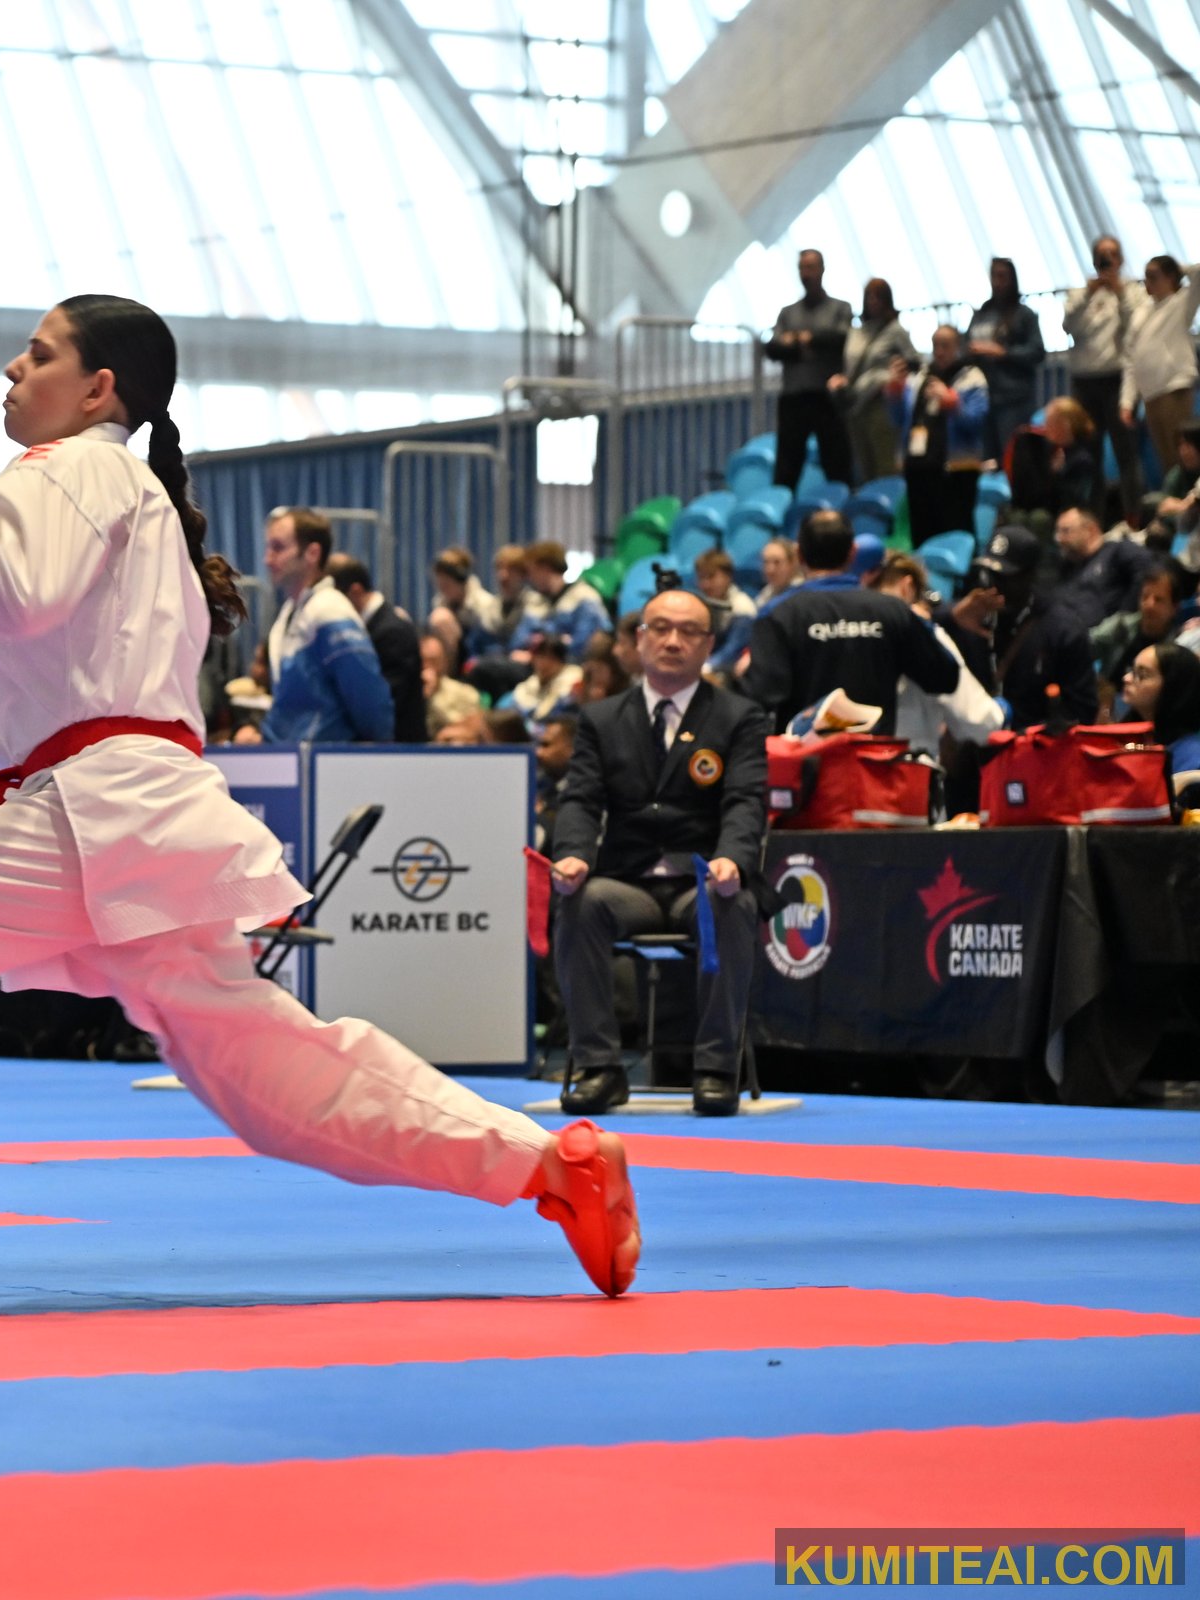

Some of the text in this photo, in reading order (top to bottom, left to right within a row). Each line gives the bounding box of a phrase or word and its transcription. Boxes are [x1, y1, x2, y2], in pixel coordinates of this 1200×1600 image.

[808, 619, 883, 642] QUÉBEC
[352, 912, 490, 932] KARATE BC
[950, 924, 1023, 950] KARATE
[949, 951, 1023, 977] CANADA
